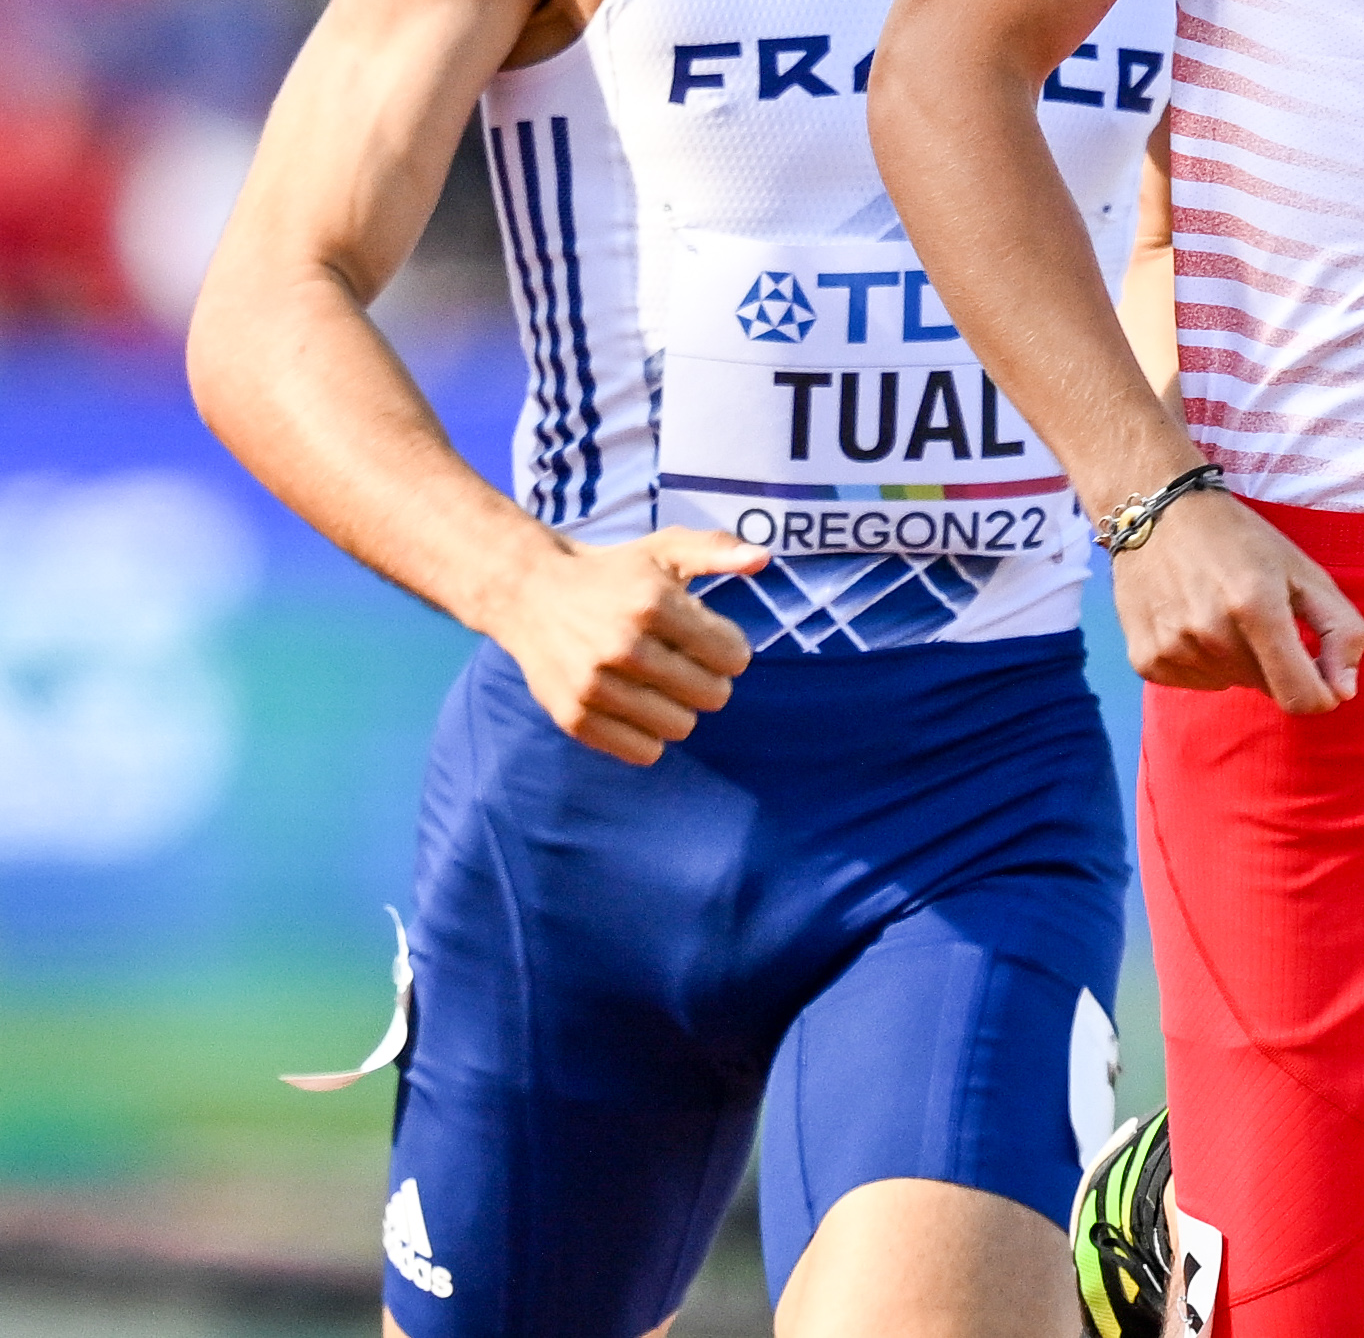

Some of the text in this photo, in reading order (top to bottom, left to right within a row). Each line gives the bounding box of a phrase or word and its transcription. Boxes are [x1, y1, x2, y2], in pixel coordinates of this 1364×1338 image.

[668, 34, 1164, 114] FRCE
[817, 269, 962, 345] TD
[773, 368, 1026, 464] TUAL
[736, 506, 1048, 552] OREGON22
